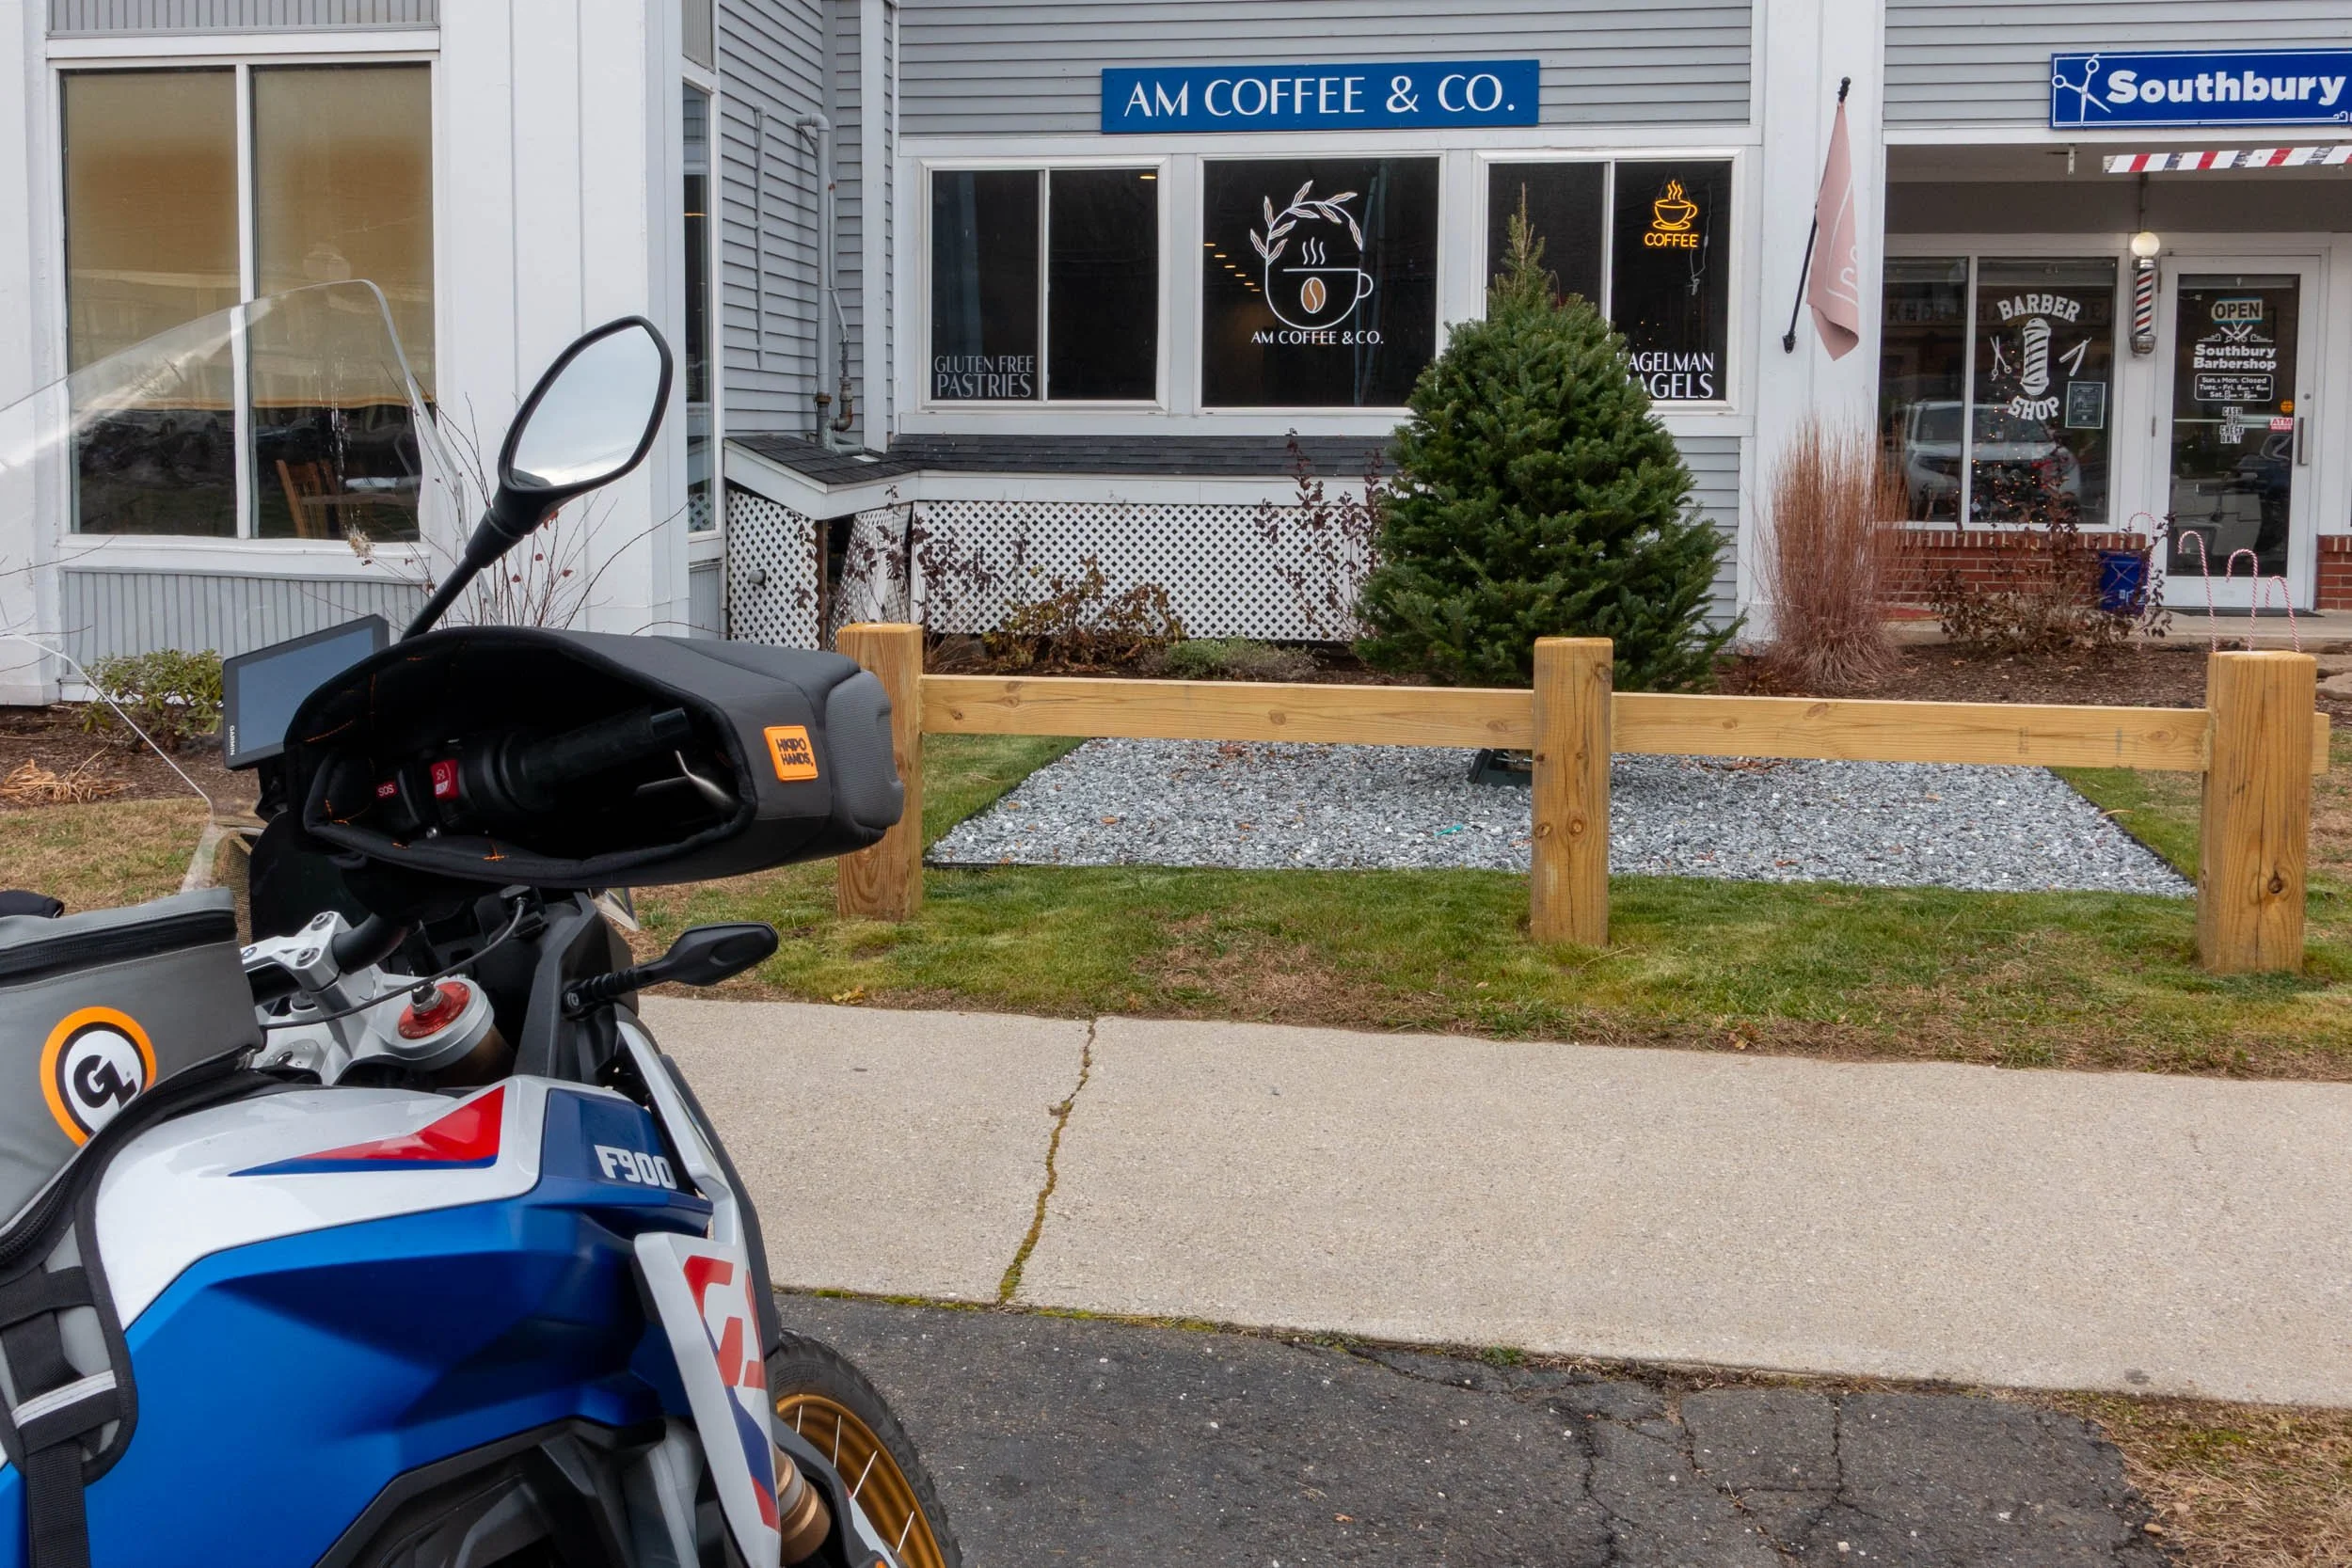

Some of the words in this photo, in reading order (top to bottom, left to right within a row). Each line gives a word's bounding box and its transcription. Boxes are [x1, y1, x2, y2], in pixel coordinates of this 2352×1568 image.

[1124, 80, 1189, 118] AM
[1204, 76, 1365, 117] COFFEE
[1385, 75, 1420, 113] &
[1438, 73, 1516, 113] CO.
[2106, 70, 2347, 106] Southbury
[1644, 231, 1700, 249] COFFEE
[1996, 293, 2080, 323] BARBER
[2214, 303, 2260, 319] OPEN
[1251, 330, 1274, 344] AM
[1278, 330, 1337, 345] COFFEE
[2194, 343, 2276, 358] Southbury
[934, 355, 993, 373] GLUTEN
[998, 355, 1035, 373] FREE
[1616, 352, 1714, 372] AGELMAN
[2193, 356, 2277, 372] Barbershop
[937, 372, 1032, 398] PASTRIES
[2008, 396, 2059, 420] SHOP
[377, 784, 395, 797] SOS
[593, 1144, 678, 1190] F900
